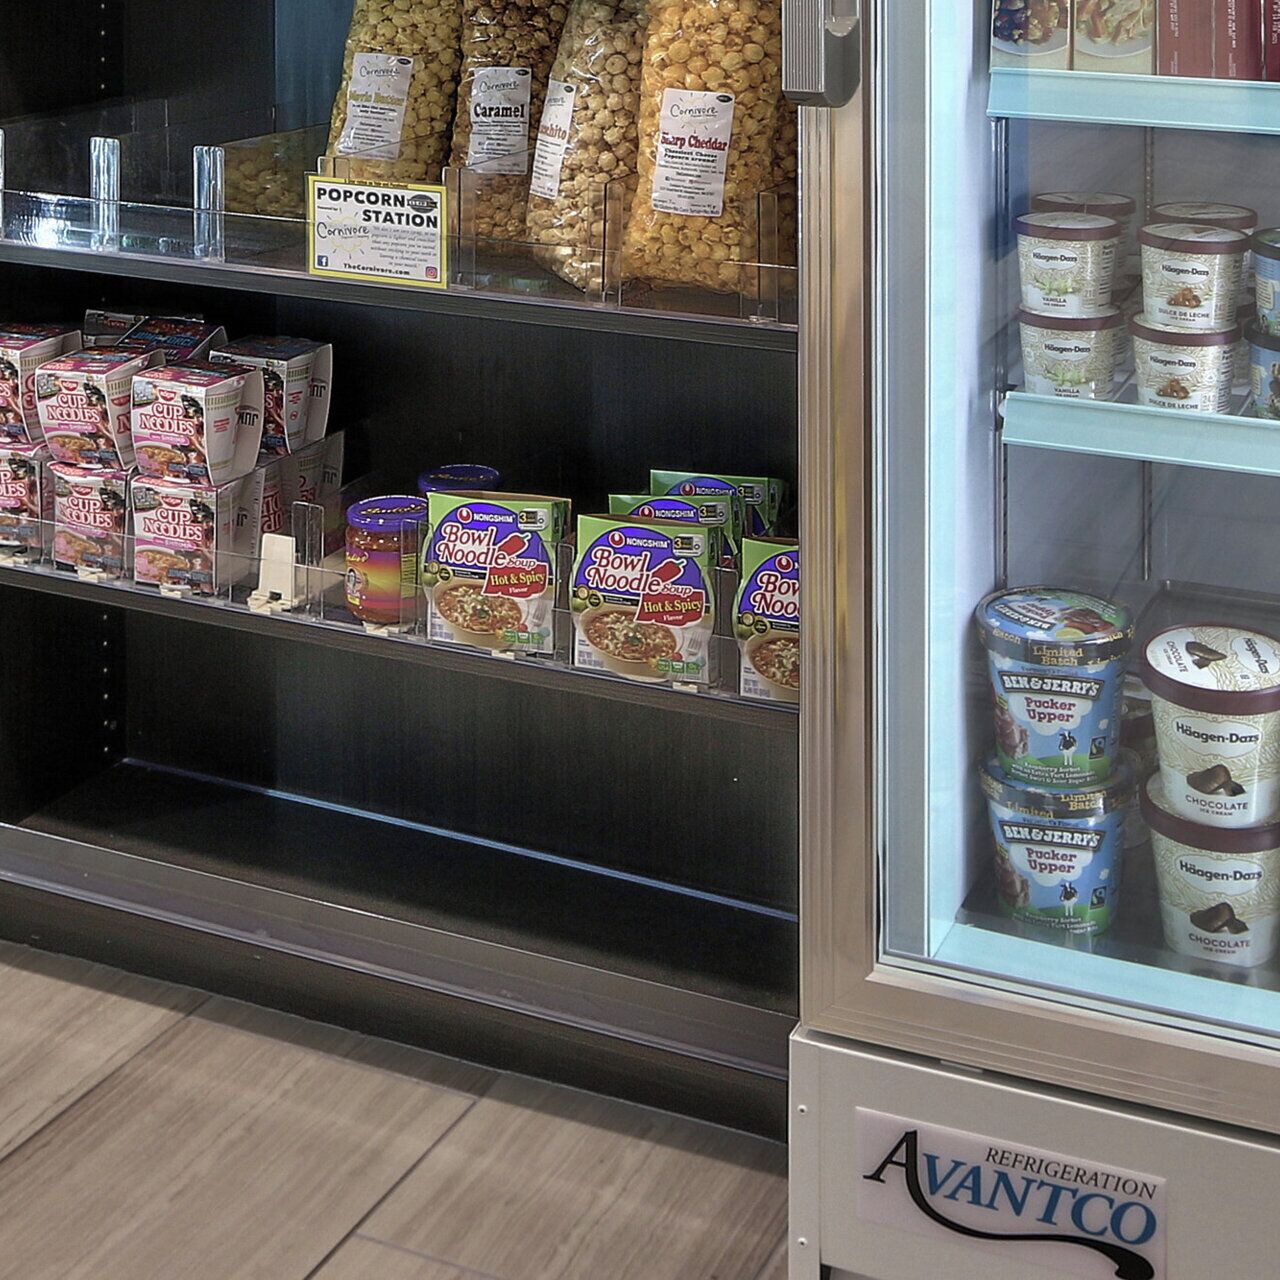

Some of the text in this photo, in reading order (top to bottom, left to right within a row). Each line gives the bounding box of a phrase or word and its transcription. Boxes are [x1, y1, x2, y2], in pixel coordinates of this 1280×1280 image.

[474, 103, 525, 118] Caramel
[688, 135, 727, 151] Cheddar
[317, 187, 405, 207] POPCORN
[363, 209, 438, 228] STATION
[57, 394, 87, 407] CUP
[47, 405, 99, 423] NOODLES
[152, 402, 183, 418] CUP
[139, 416, 194, 435] NOODLES
[155, 509, 191, 523] CUP
[474, 513, 513, 523] NONGSHIM
[143, 519, 202, 540] NOODLES
[446, 523, 496, 547] Bowl
[626, 536, 668, 549] NONGSHIM
[438, 543, 536, 569] Noodle Soup
[596, 549, 648, 573] Bowl
[491, 572, 545, 586] Hot & Spicy
[588, 568, 692, 595] Noodle Soup
[644, 598, 703, 613] Hot & Spicy
[1025, 697, 1076, 712] Pucker
[1026, 709, 1074, 723] Upper
[1175, 723, 1259, 744] Häagen-Dazs
[1185, 794, 1248, 811] CHOCOLATE
[1026, 848, 1077, 863] Pucker
[1028, 860, 1075, 874] Upper
[1179, 859, 1262, 881] Häagen-Dazs
[1188, 933, 1250, 949] CHOCOLATE
[986, 1148, 1157, 1200] REFRIGERATION
[862, 1130, 1157, 1249] AVANTCO
